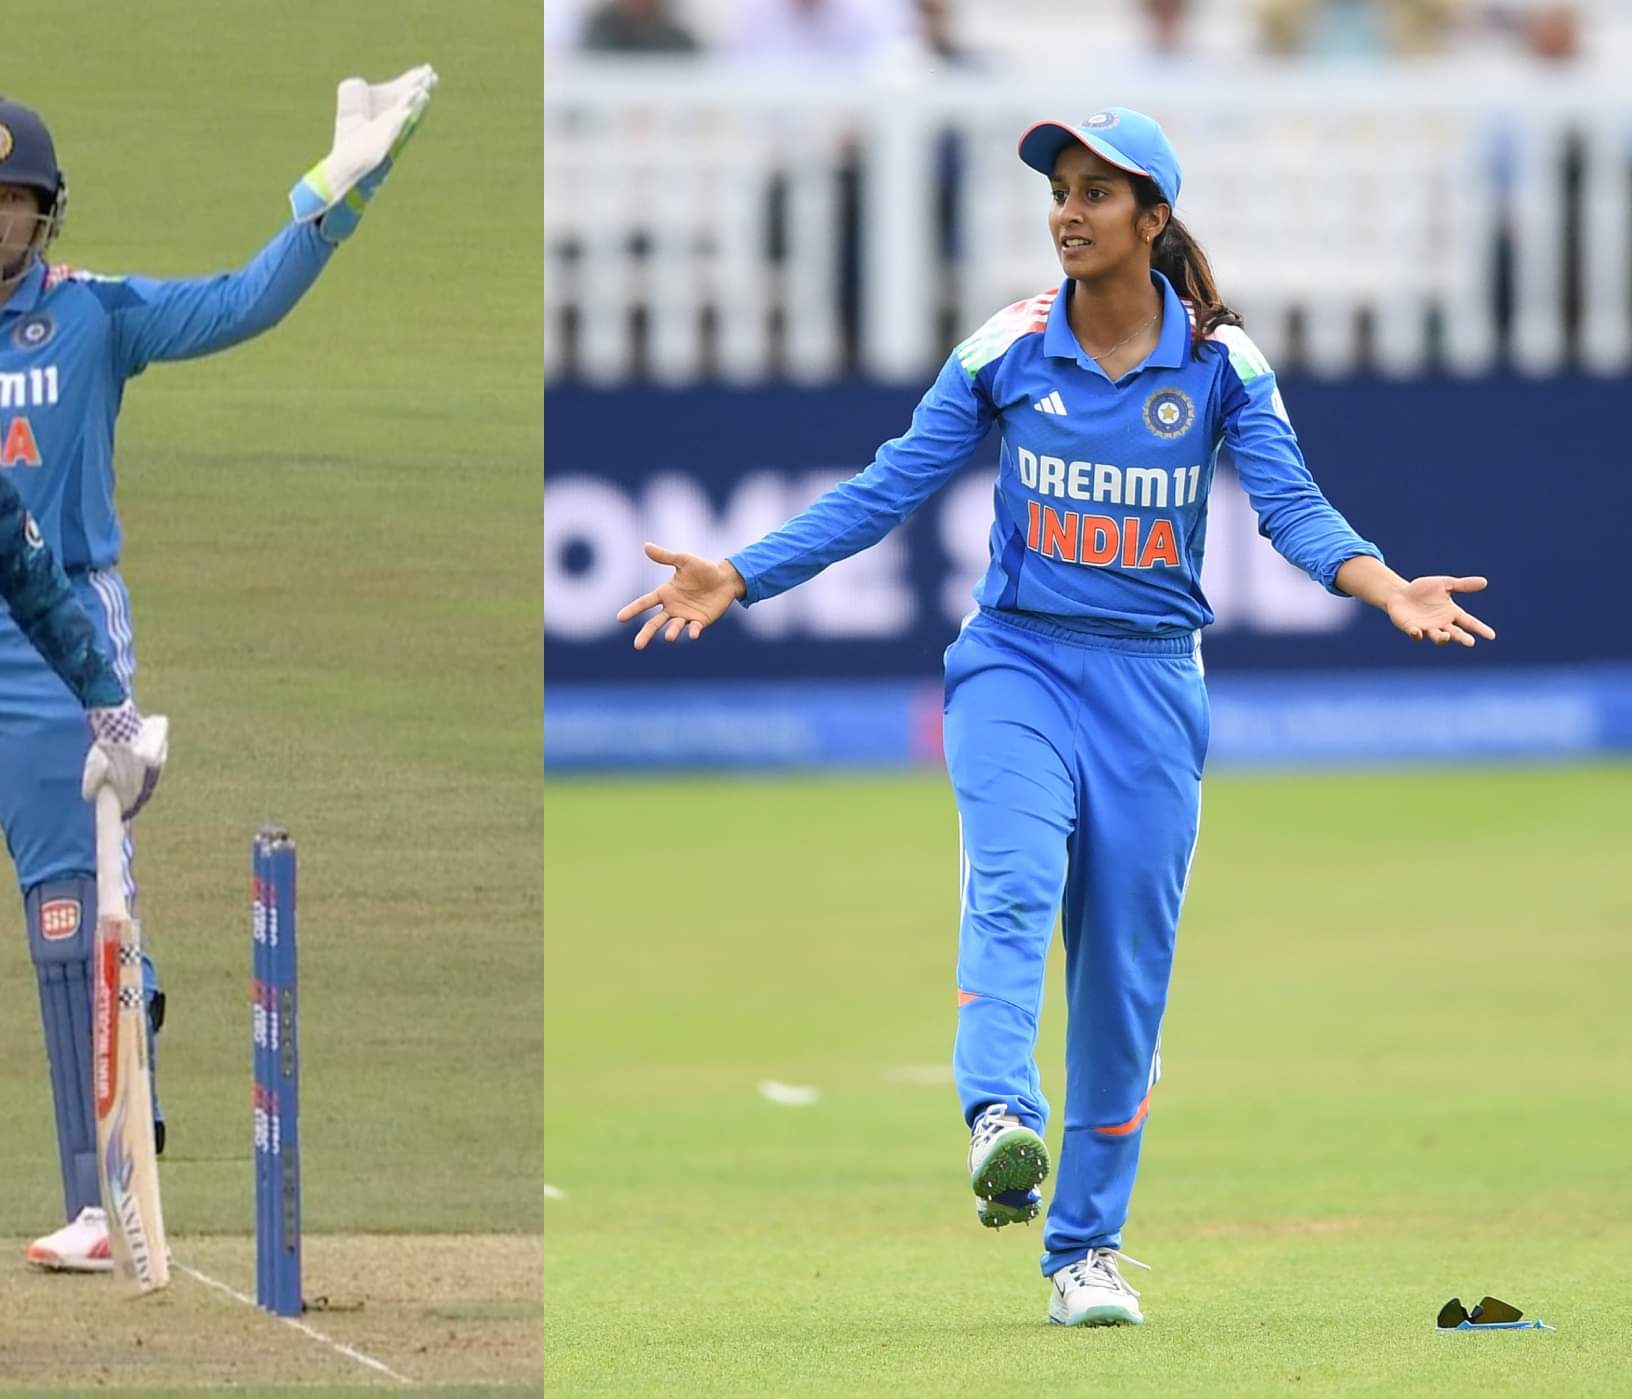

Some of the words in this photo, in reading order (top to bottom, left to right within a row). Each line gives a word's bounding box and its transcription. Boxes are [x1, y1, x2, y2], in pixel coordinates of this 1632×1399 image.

[1017, 446, 1201, 508] DREAM11
[1026, 499, 1181, 569] INDIA
[43, 907, 76, 931] SS
